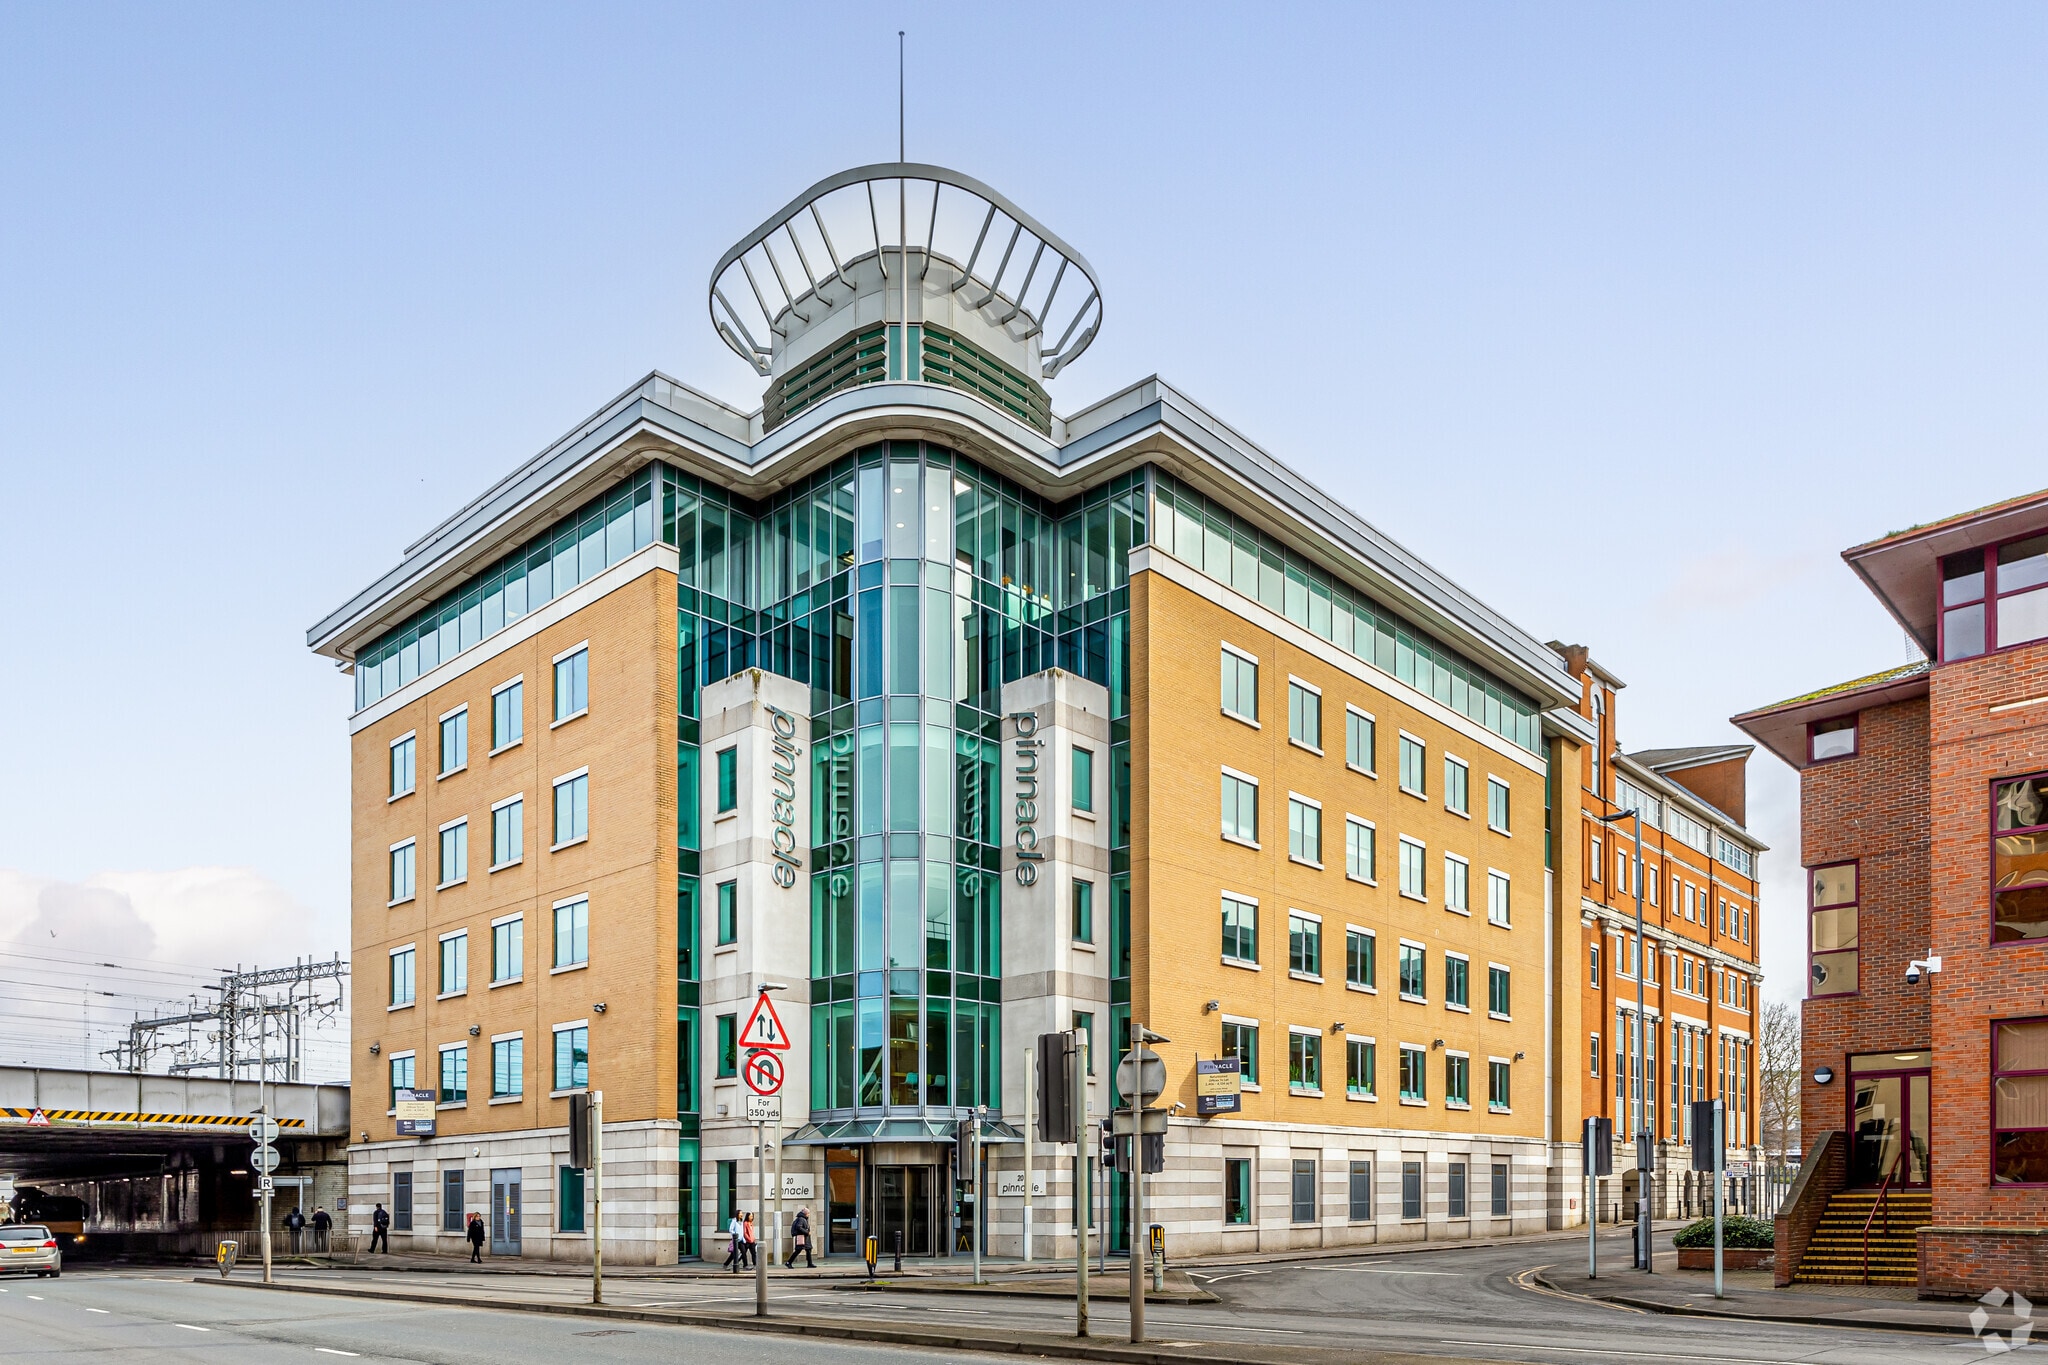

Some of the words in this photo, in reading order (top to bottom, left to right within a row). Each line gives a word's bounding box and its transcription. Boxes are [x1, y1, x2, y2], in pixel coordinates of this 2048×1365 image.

[764, 703, 802, 888] pinnacle
[1009, 711, 1045, 887] pinnacle
[757, 1098, 770, 1106] For
[749, 1109, 765, 1117] 350
[766, 1109, 779, 1118] yds
[263, 1179, 270, 1187] R
[786, 1177, 794, 1185] 20
[770, 1186, 809, 1197] pnacle
[1002, 1183, 1039, 1194] pinnale
